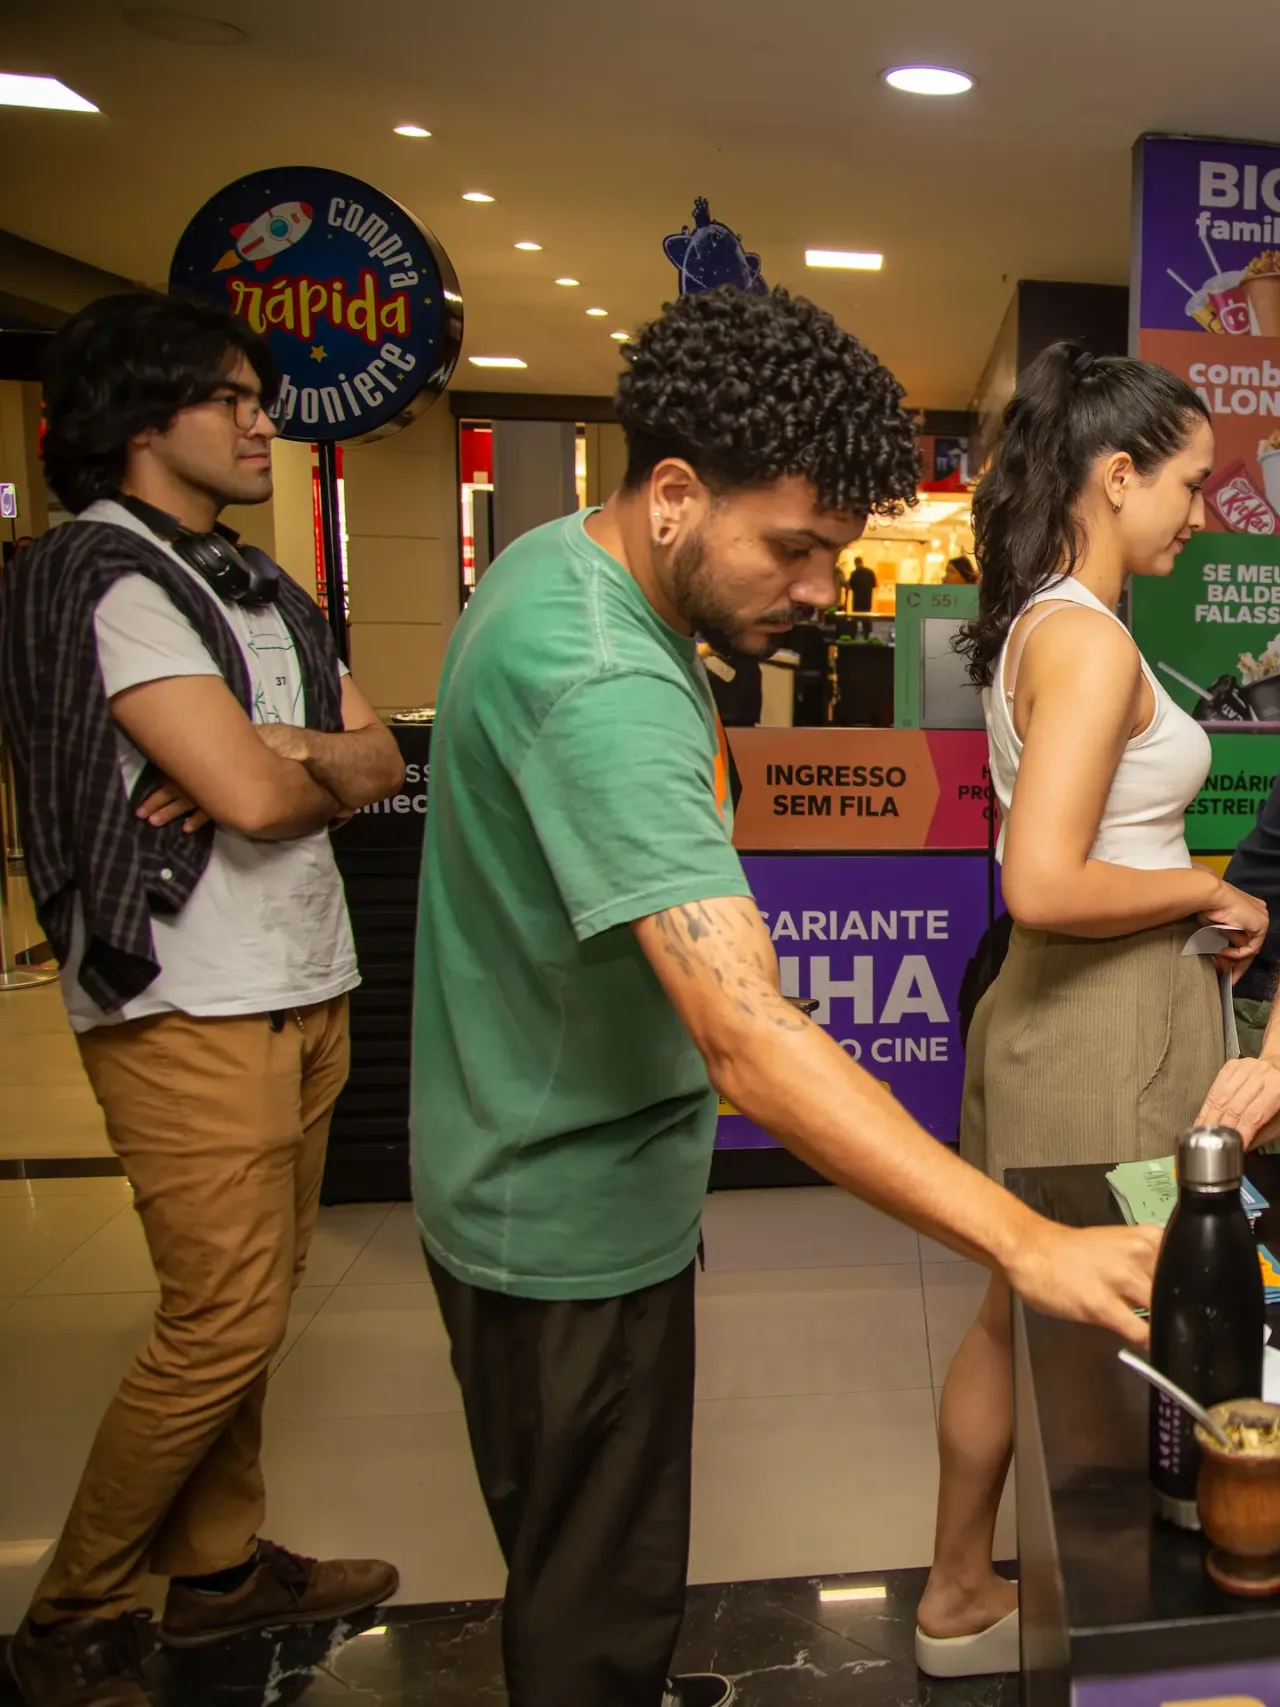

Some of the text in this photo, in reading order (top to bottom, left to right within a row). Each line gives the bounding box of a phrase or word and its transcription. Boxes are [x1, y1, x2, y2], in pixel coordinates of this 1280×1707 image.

[327, 197, 419, 288] compra
[231, 274, 406, 341] rápida
[1203, 563, 1231, 582] SE
[766, 764, 907, 788] INGRESSO
[1199, 769, 1277, 793] NDÁRI
[772, 795, 899, 817] SEM FILA
[1184, 797, 1267, 815] ESTREI
[871, 1037, 949, 1063] CINE
